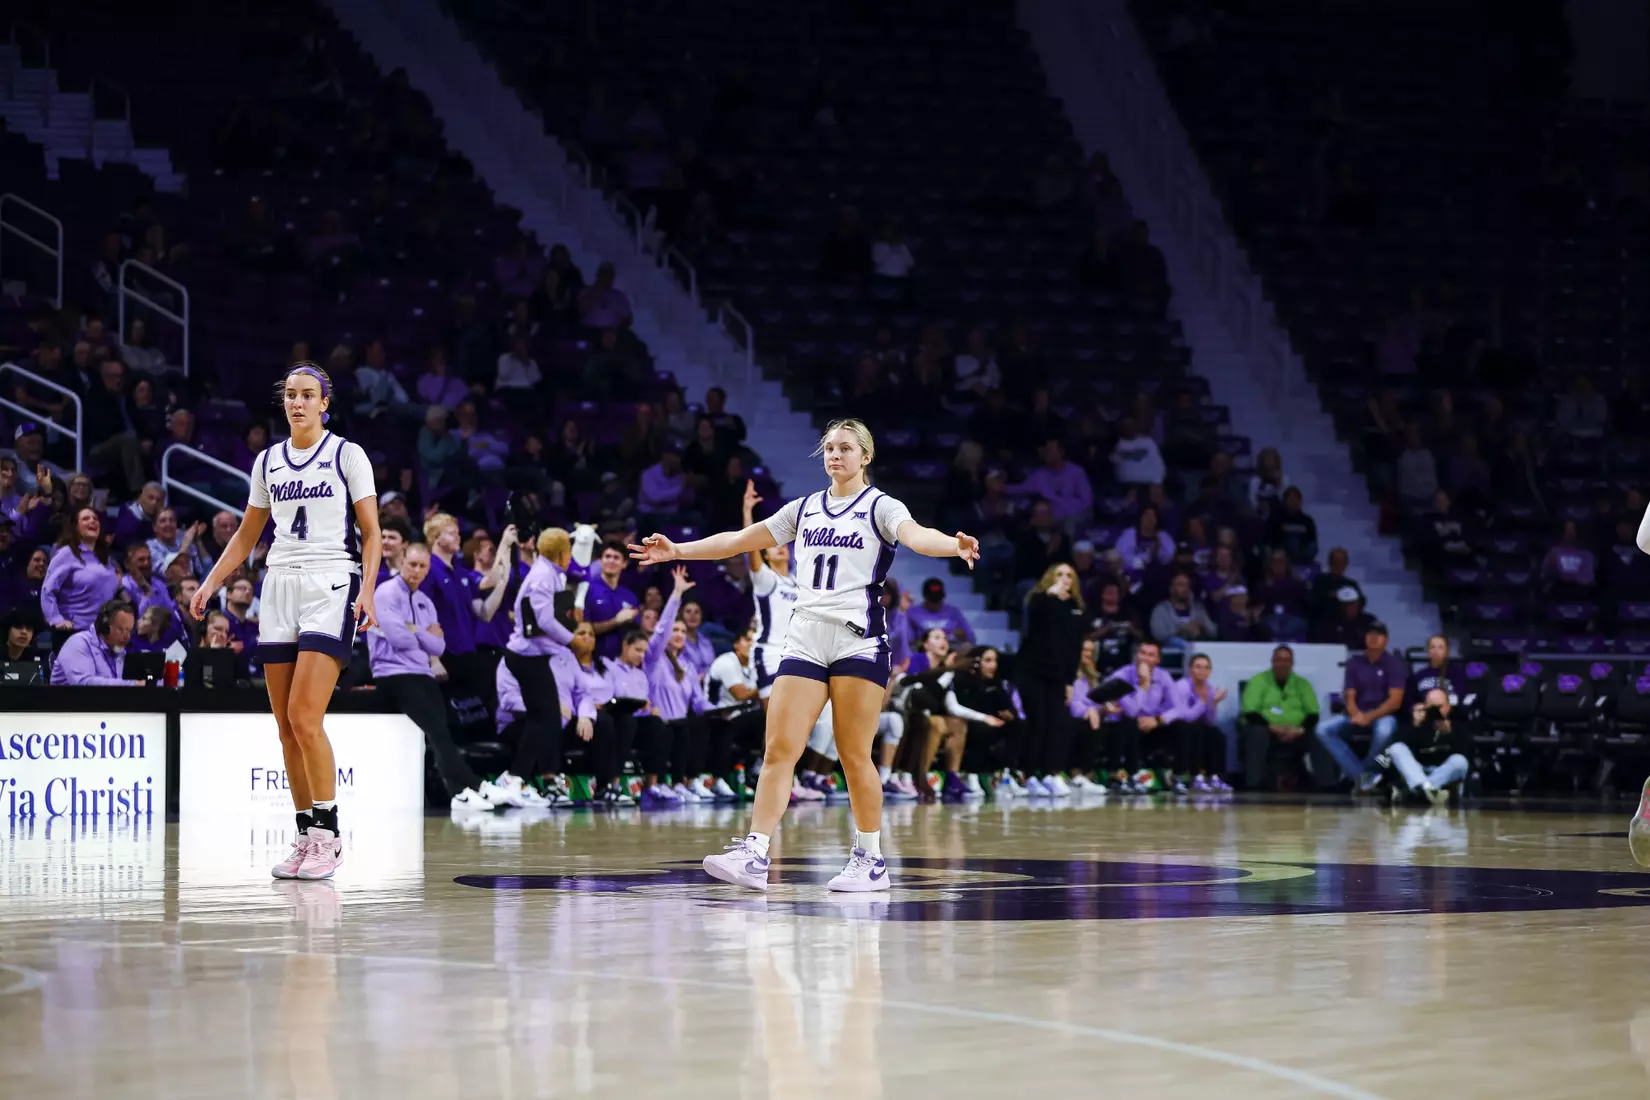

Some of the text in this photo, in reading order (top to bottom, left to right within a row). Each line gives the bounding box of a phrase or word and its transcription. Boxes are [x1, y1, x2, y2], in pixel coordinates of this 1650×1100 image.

[270, 480, 334, 503] Wildcats
[291, 505, 308, 541] 4
[803, 527, 864, 550] Wildcats
[812, 553, 839, 590] 11
[251, 767, 354, 790] FREM
[44, 776, 154, 817] Christi
